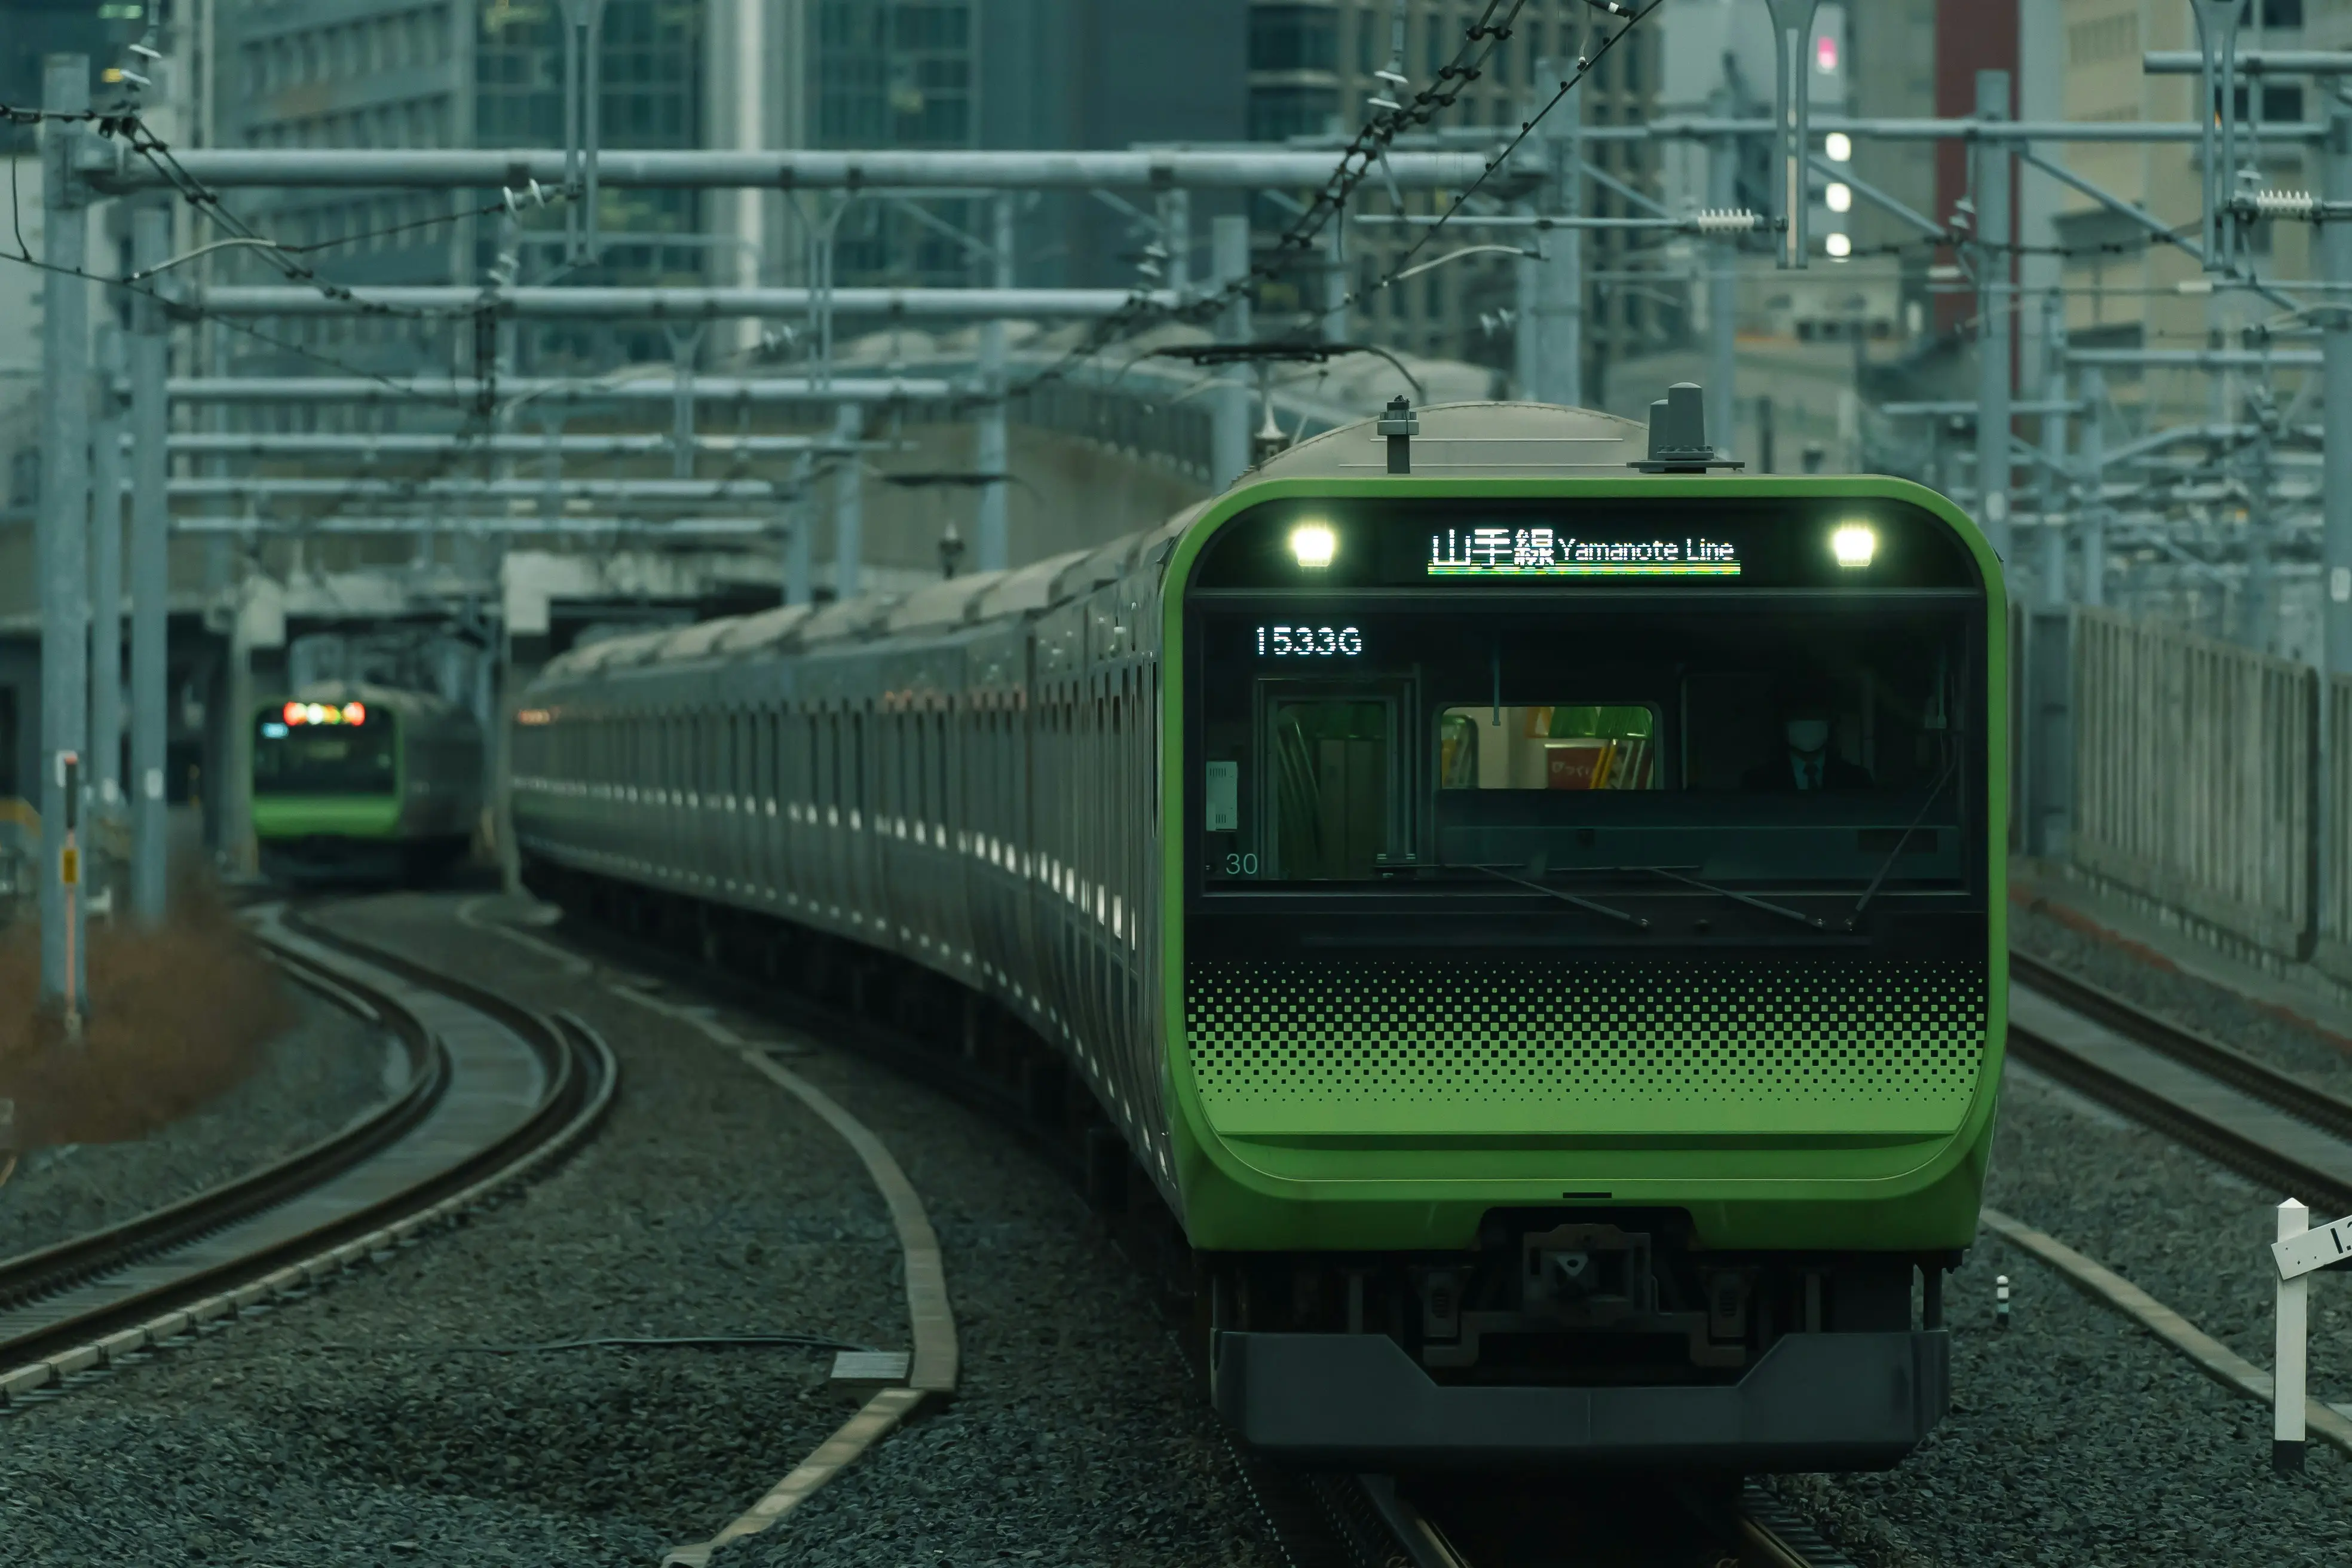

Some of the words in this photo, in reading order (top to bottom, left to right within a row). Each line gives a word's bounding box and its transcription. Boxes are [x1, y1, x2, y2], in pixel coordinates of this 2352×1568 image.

[1433, 529, 1555, 566] 山手線
[1558, 538, 1679, 561] Yamanote
[1687, 538, 1735, 561] Line
[1257, 627, 1362, 655] 1533G
[1226, 853, 1258, 875] 30
